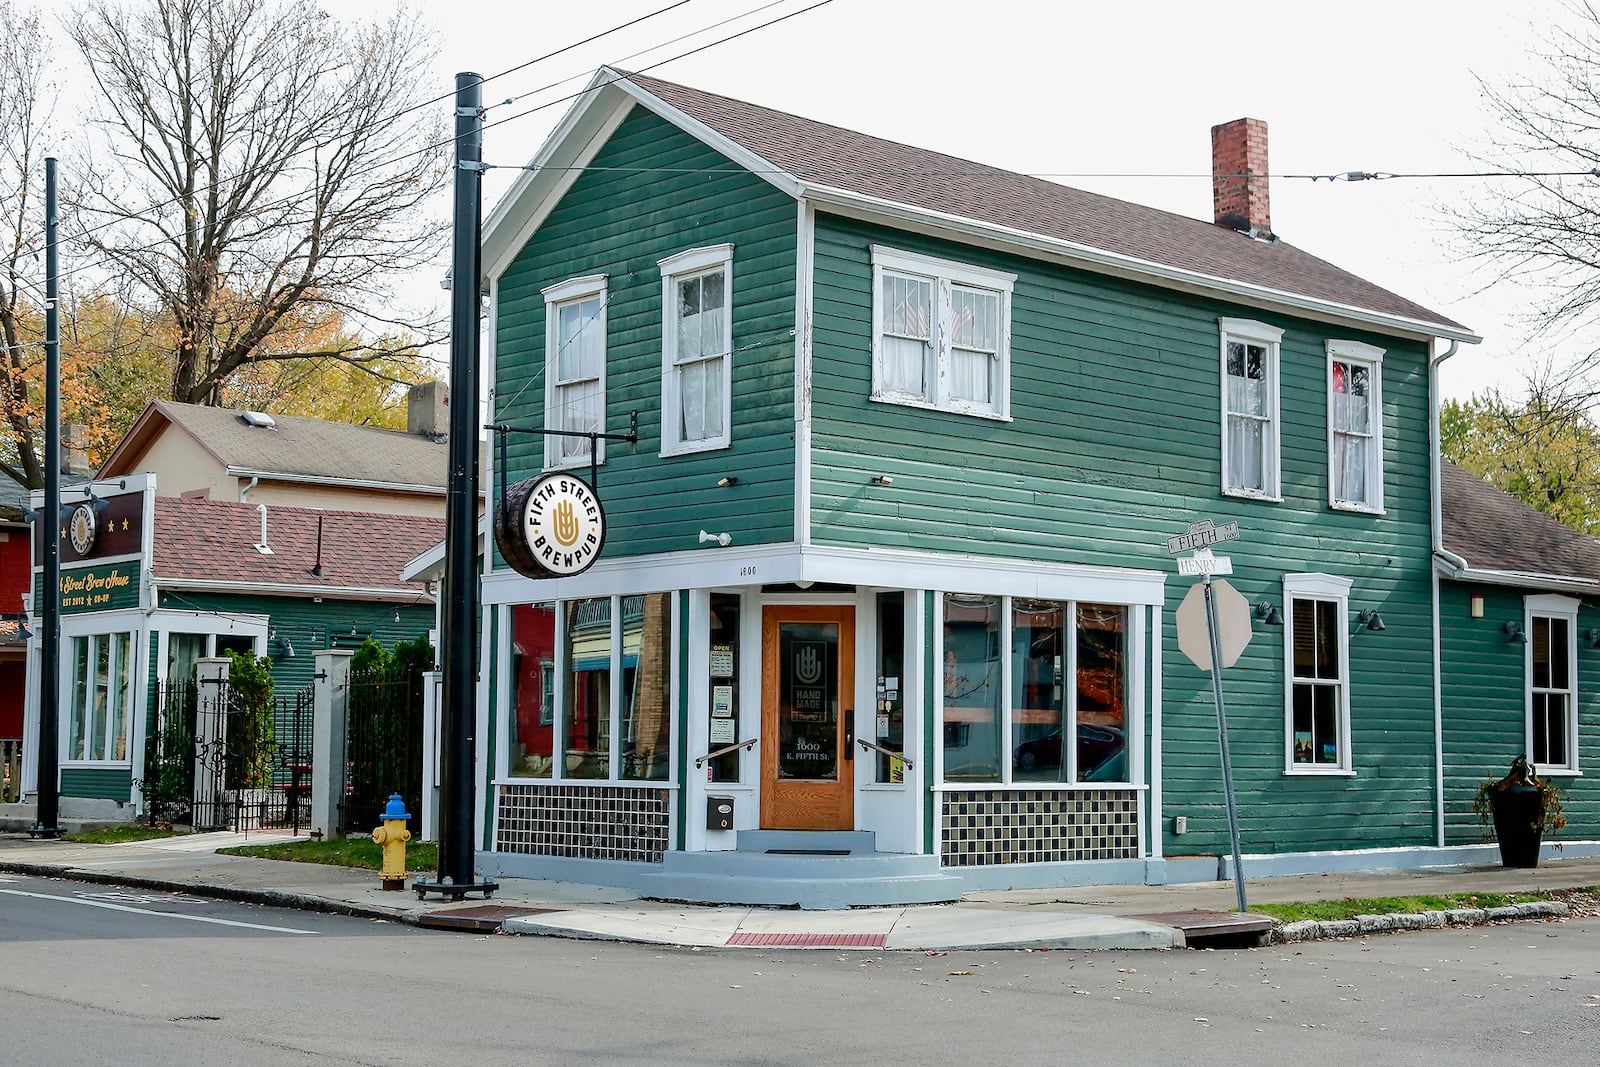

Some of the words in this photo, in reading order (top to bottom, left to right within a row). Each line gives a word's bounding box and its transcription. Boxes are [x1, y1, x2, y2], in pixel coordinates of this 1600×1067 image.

[529, 483, 556, 526] FIFTH
[560, 480, 598, 524] STREET
[1178, 529, 1217, 549] FIFTH
[534, 533, 597, 567] BREWPUB
[1180, 560, 1217, 573] HENRY
[63, 576, 86, 594] Street
[86, 573, 105, 591] Brew
[105, 570, 129, 589] House
[63, 597, 71, 607] EST
[72, 597, 84, 606] 2012
[94, 593, 110, 604] CO-OP
[796, 690, 821, 700] HAND
[796, 700, 821, 709] MADE
[797, 742, 820, 751] 1600
[795, 752, 819, 760] FIFTH
